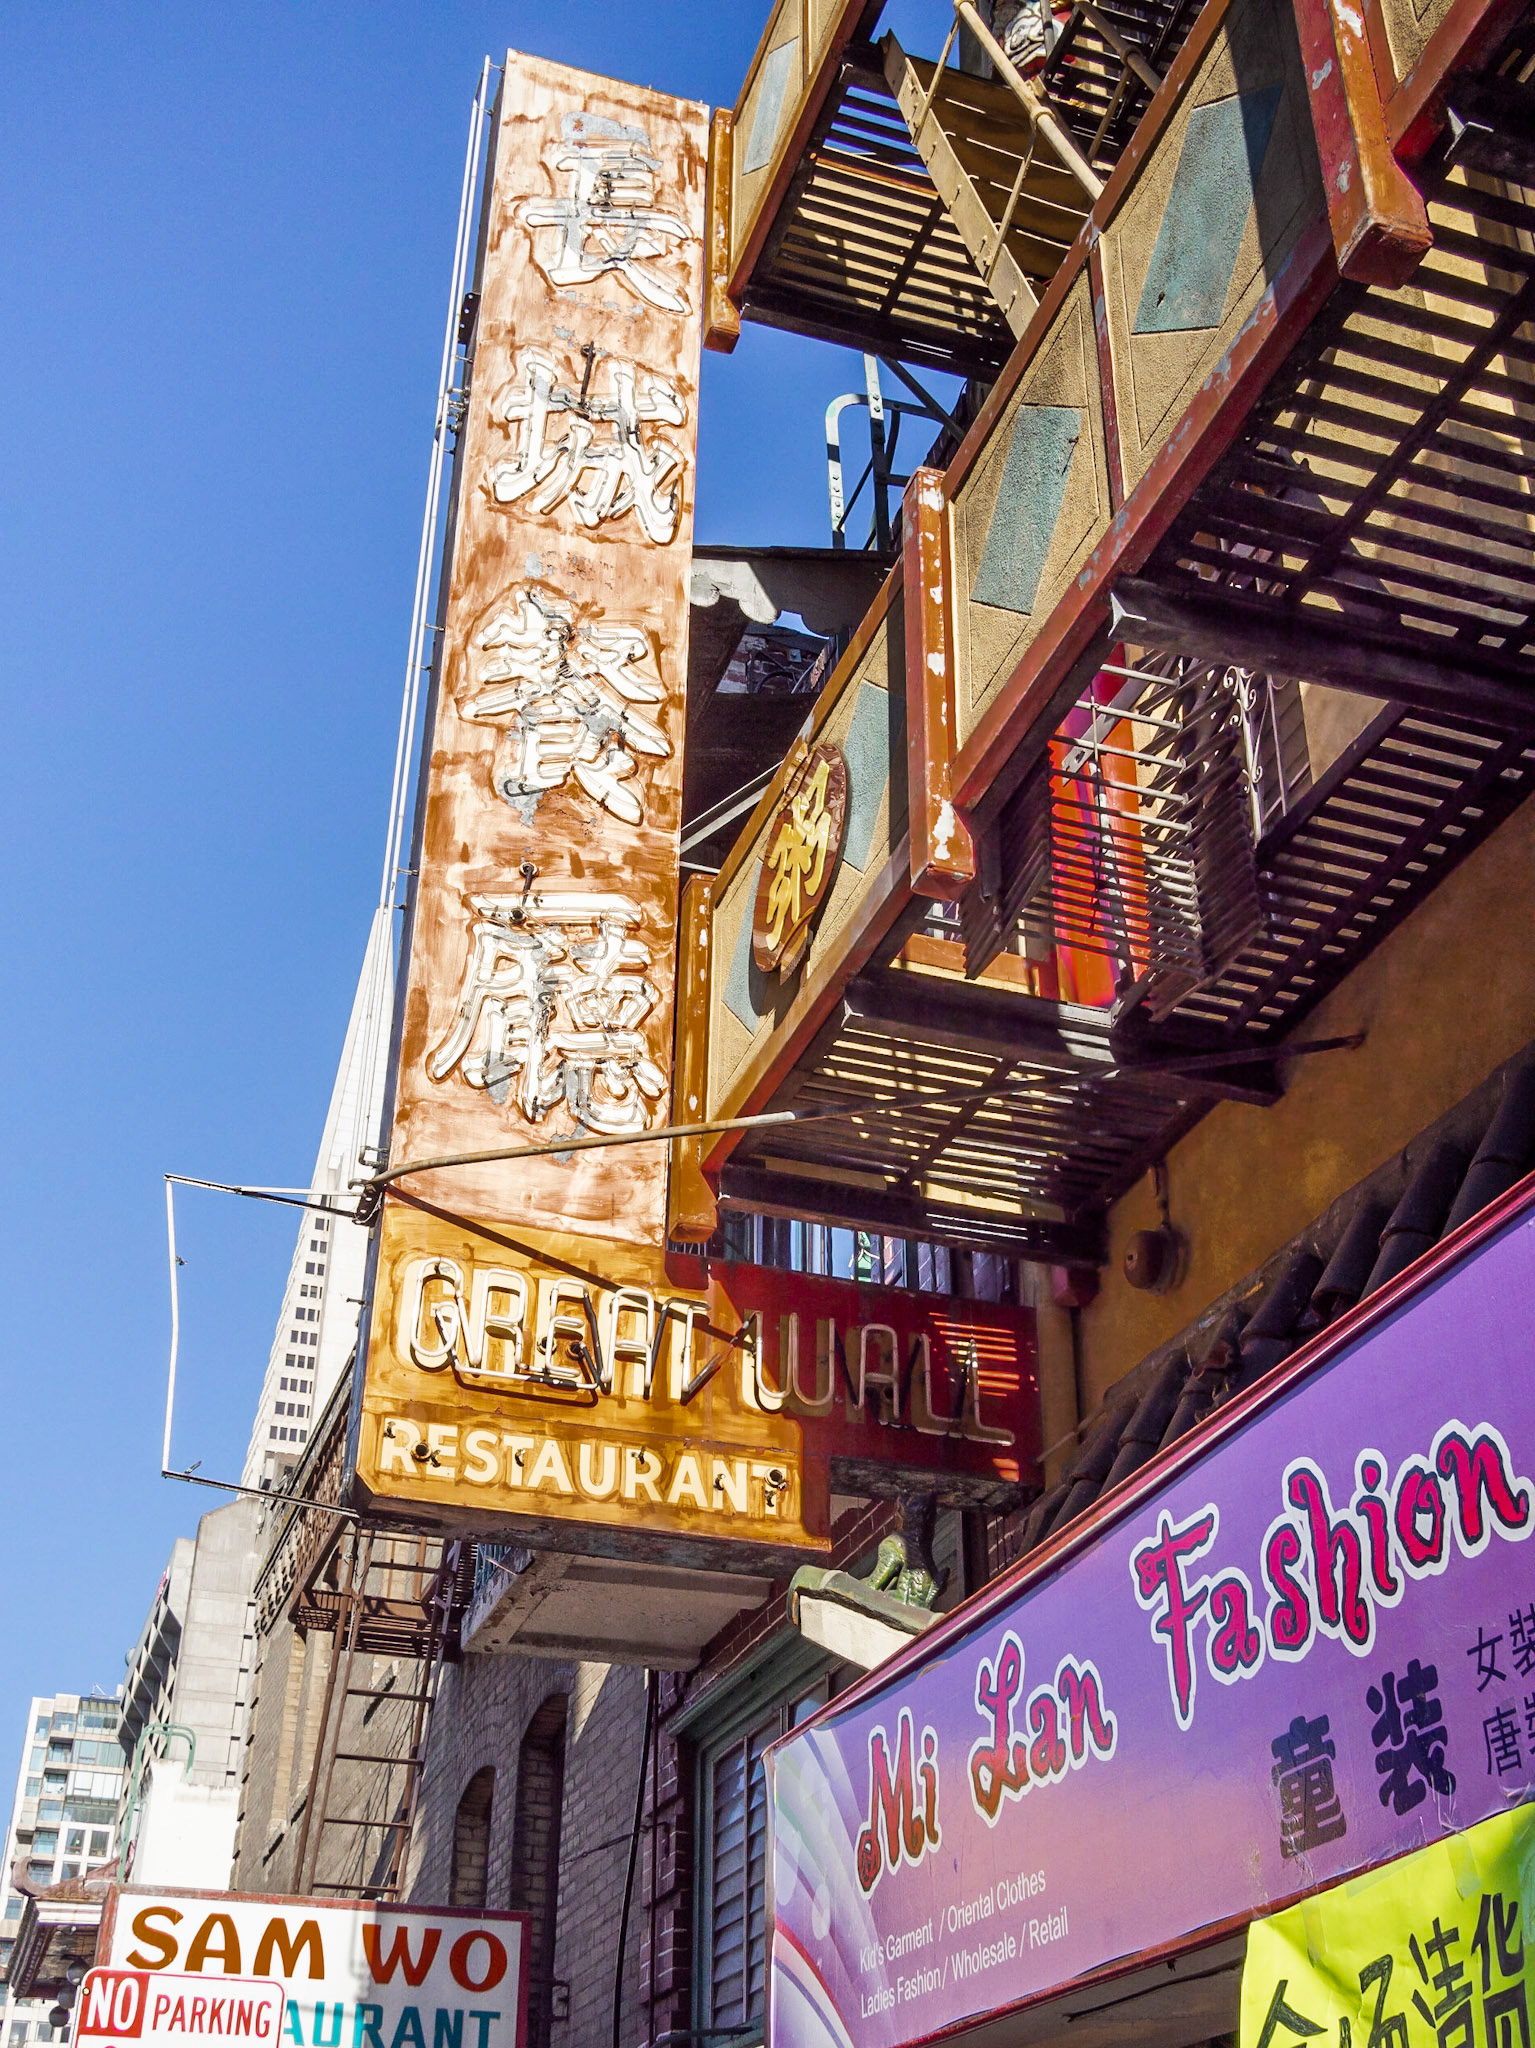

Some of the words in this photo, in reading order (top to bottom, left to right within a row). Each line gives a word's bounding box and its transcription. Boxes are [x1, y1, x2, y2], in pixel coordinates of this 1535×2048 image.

[400, 1257, 712, 1399] GREAT
[743, 1309, 1016, 1446] WALL
[379, 1416, 788, 1516] RESTAURANT
[858, 1709, 941, 1896] Mi
[968, 1631, 1117, 1826] Lan
[1130, 1420, 1535, 1730] Fashion
[1482, 1691, 1535, 1776] 唐
[126, 1906, 325, 1980] SAM
[362, 1923, 508, 1992] WO
[860, 1943, 885, 1974] Kid's
[886, 1918, 934, 1962] Garment
[947, 1887, 994, 1933] Oriental
[996, 1869, 1047, 1911] Clothes
[861, 1989, 896, 2019] Ladies
[951, 1932, 1017, 1982] Wholesale
[1029, 1905, 1070, 1950] Retail
[85, 1976, 140, 2032] NO
[152, 1994, 272, 2039] PARKING
